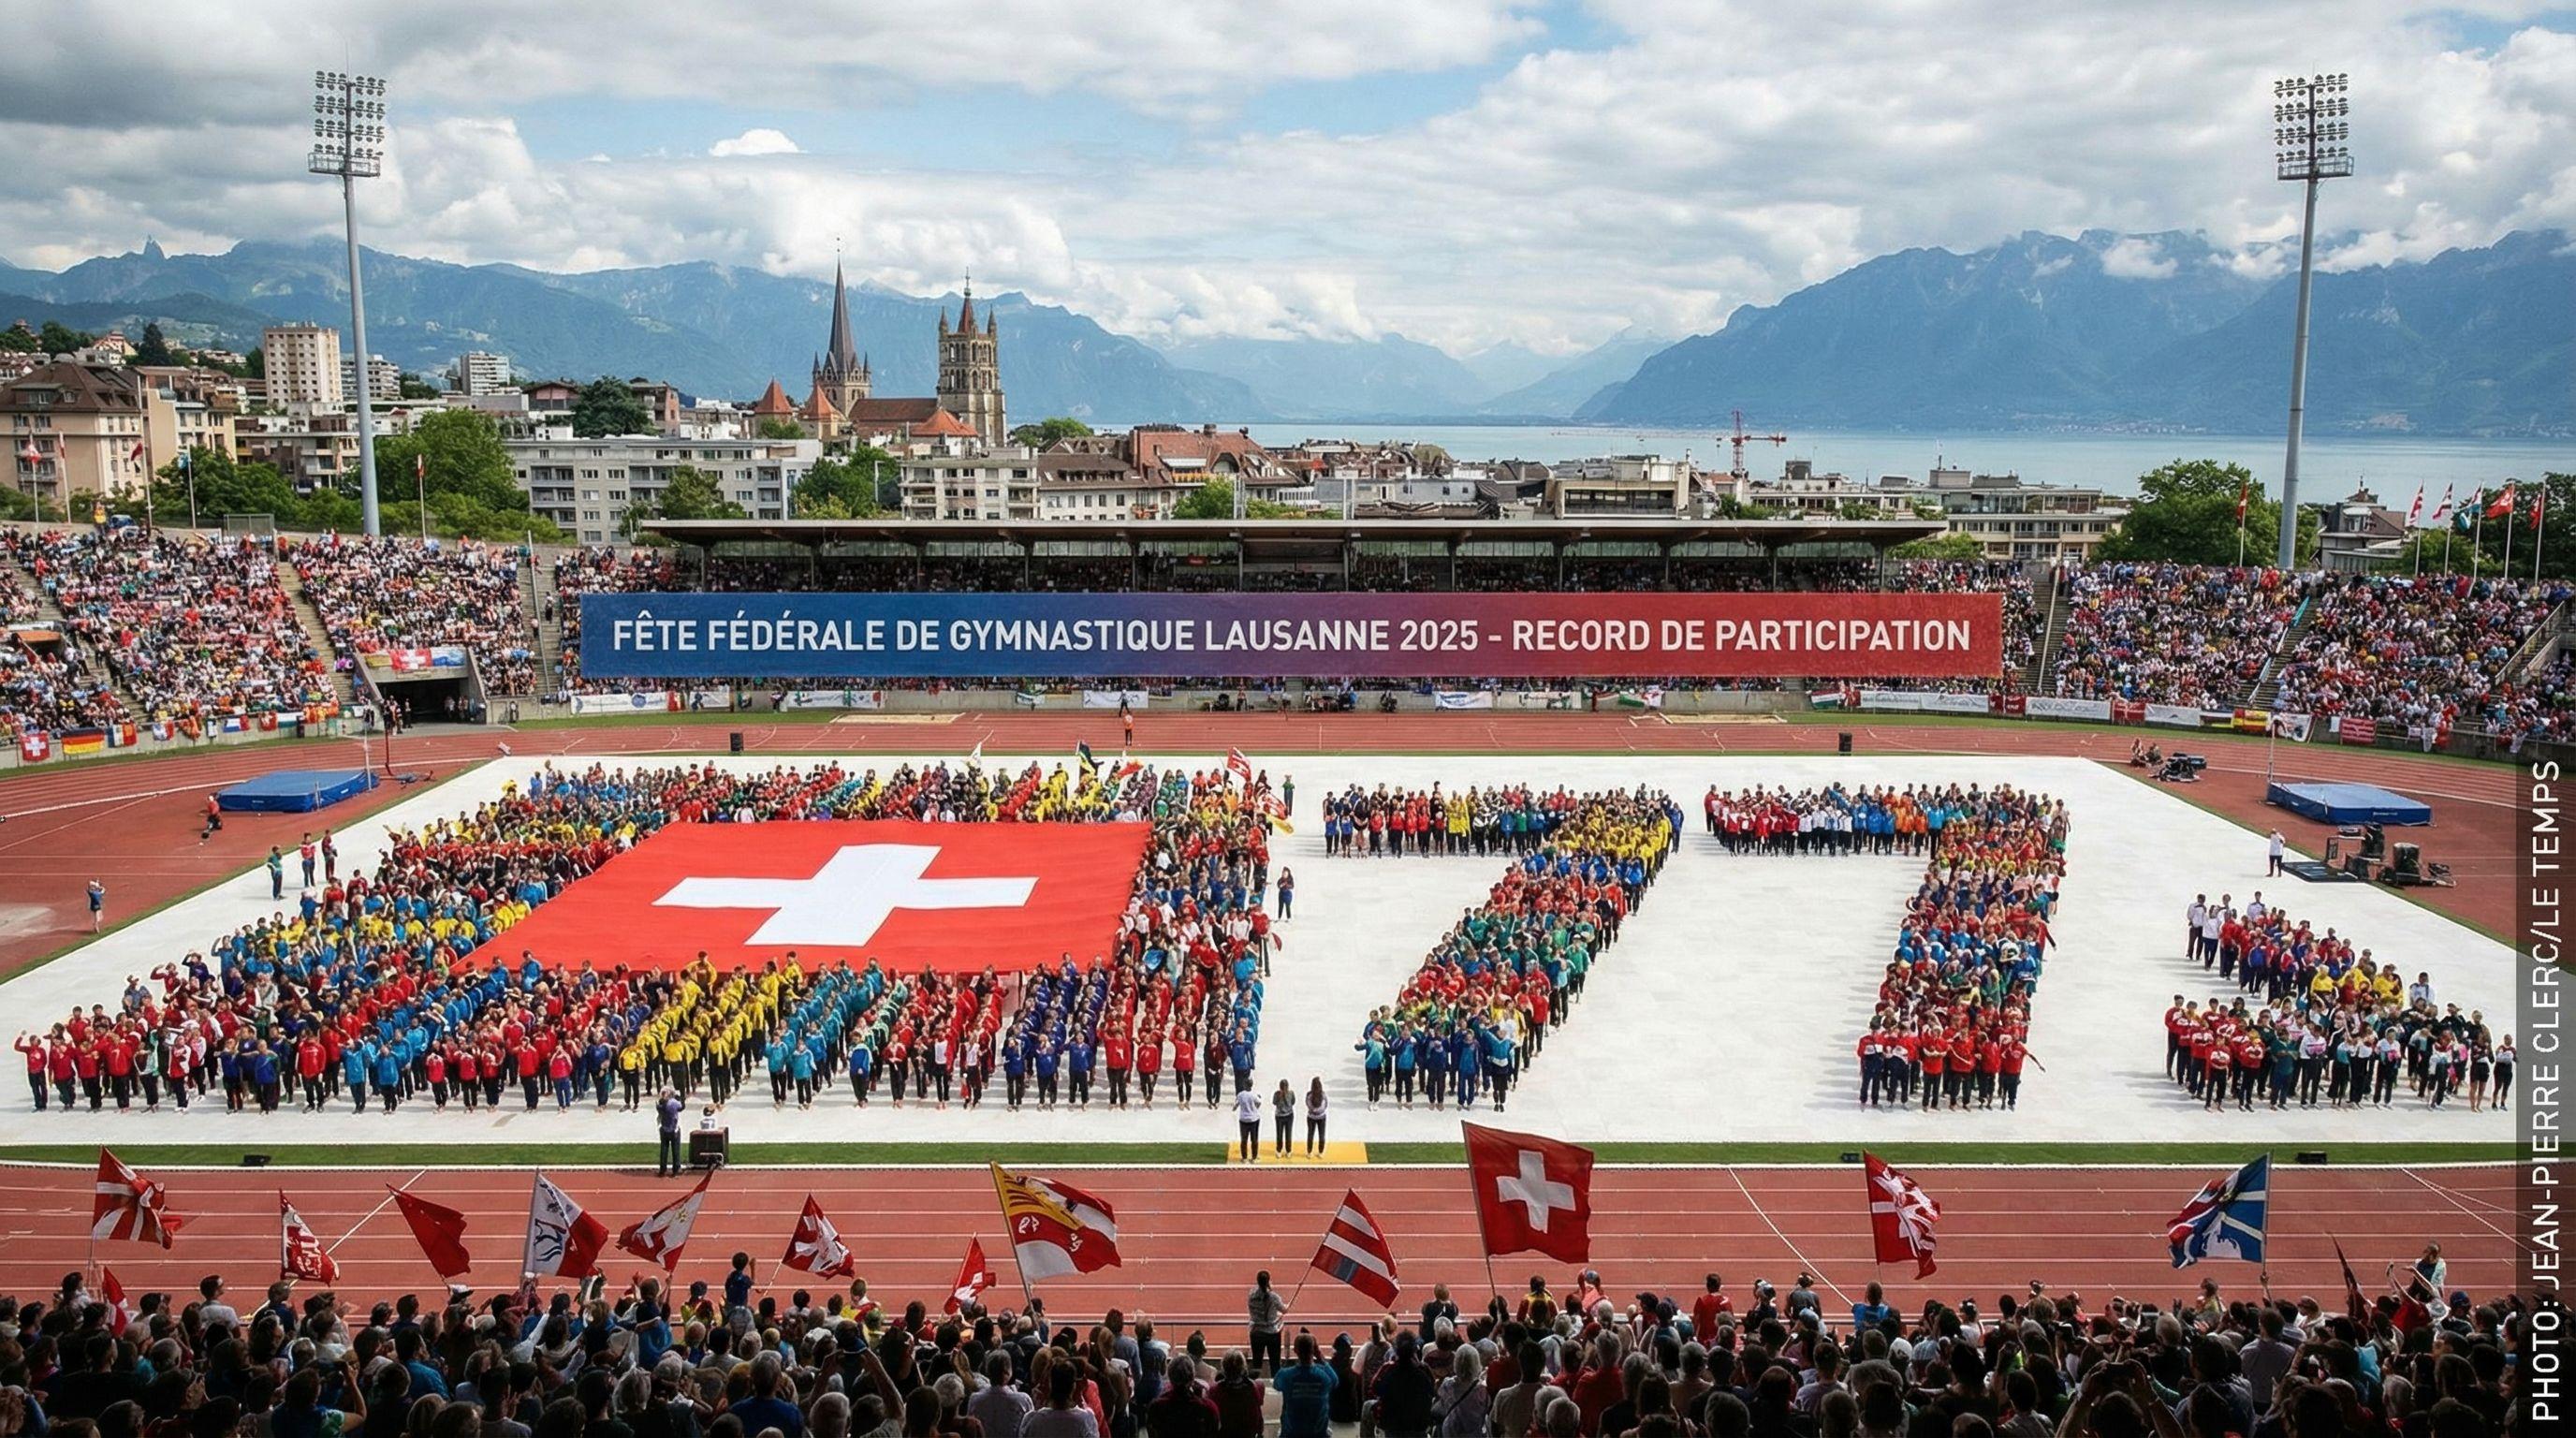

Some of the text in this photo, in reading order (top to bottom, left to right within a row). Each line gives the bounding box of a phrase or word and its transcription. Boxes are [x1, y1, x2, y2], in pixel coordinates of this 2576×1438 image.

[614, 609, 696, 651] FÊTE
[709, 609, 885, 651] FÉDÉRALE
[897, 620, 939, 651] DE
[950, 620, 1194, 653] GYMNASTIQUE
[1206, 620, 1389, 651] LAUSANNE
[1400, 620, 1478, 651] 2025
[1513, 620, 1650, 651] RECORD
[1661, 620, 1705, 651] DE
[1716, 620, 1969, 651] PARTICIPATION
